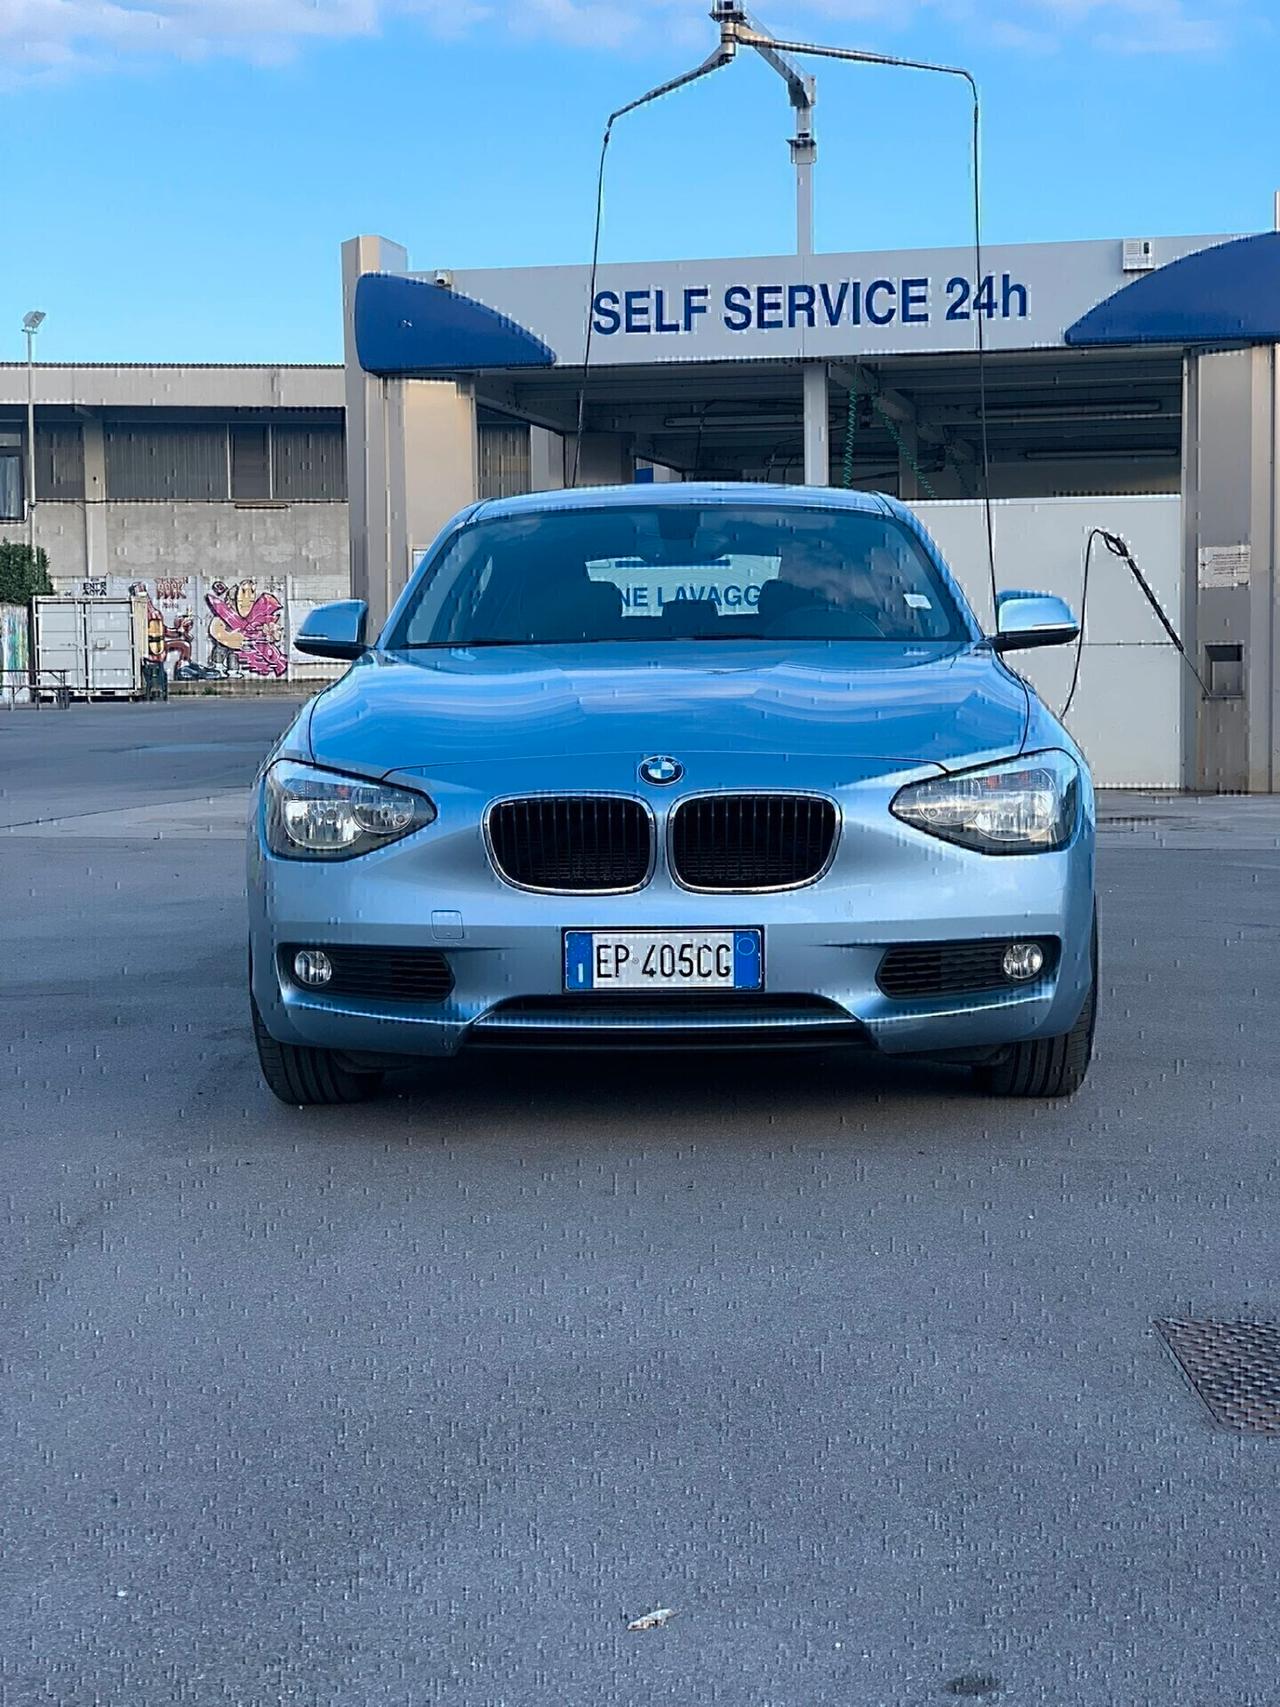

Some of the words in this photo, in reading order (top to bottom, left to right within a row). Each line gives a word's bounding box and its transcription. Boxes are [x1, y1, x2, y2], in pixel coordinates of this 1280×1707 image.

[592, 289, 709, 335] SELF
[724, 278, 929, 331] SERVICE
[946, 273, 1027, 321] 24h
[596, 944, 630, 979] EP
[641, 943, 731, 978] 405CG
